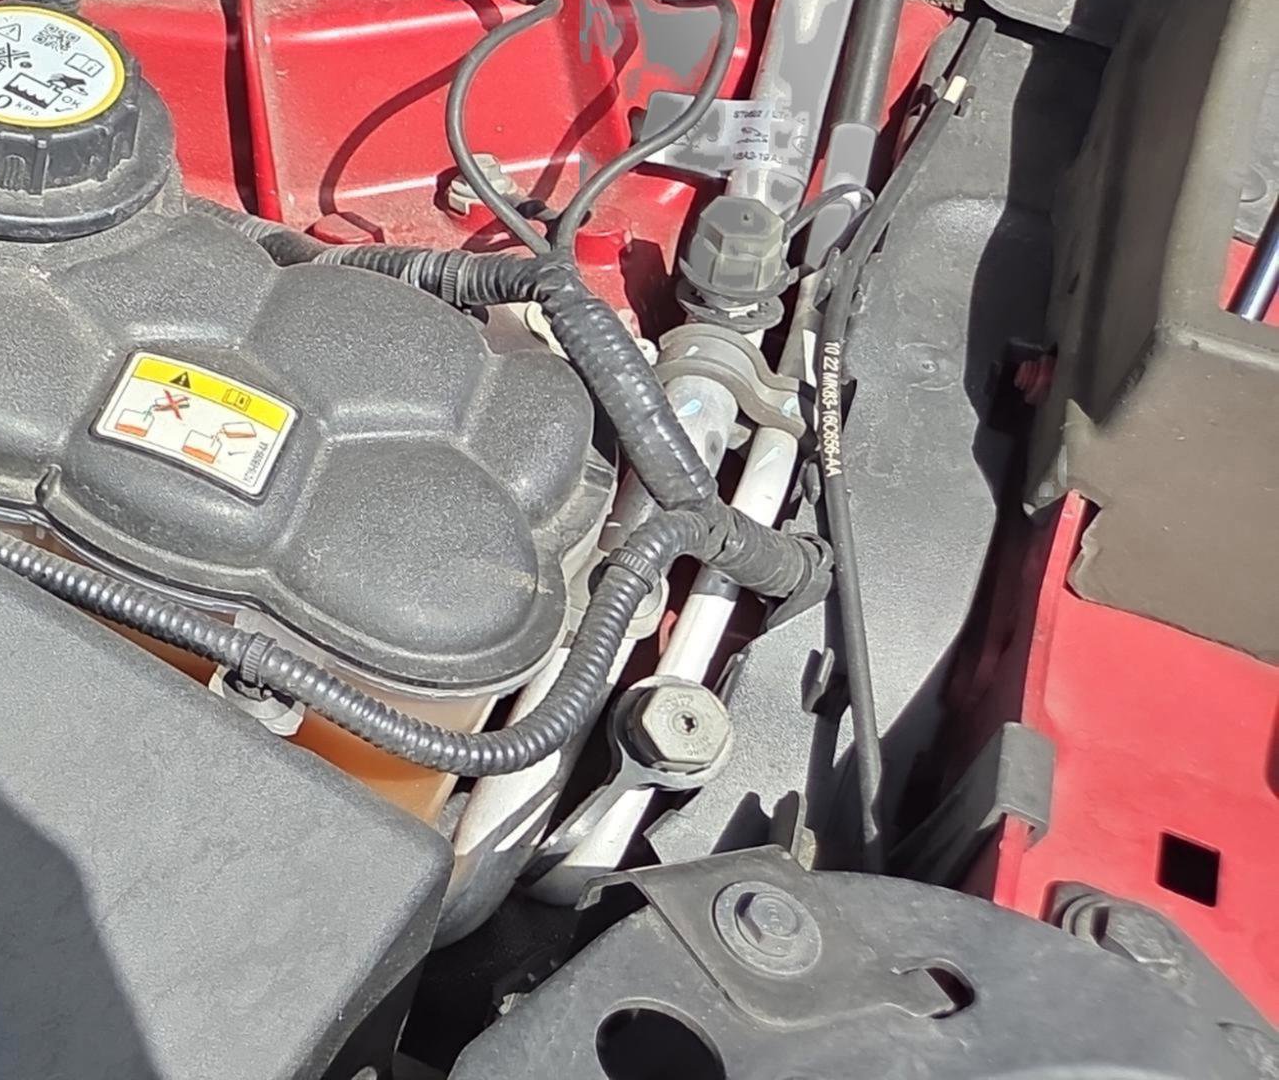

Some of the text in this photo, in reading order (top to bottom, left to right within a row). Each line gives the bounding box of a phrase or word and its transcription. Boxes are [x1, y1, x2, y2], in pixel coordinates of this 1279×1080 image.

[62, 95, 81, 108] OK
[824, 341, 840, 355] 10
[823, 357, 839, 371] 22
